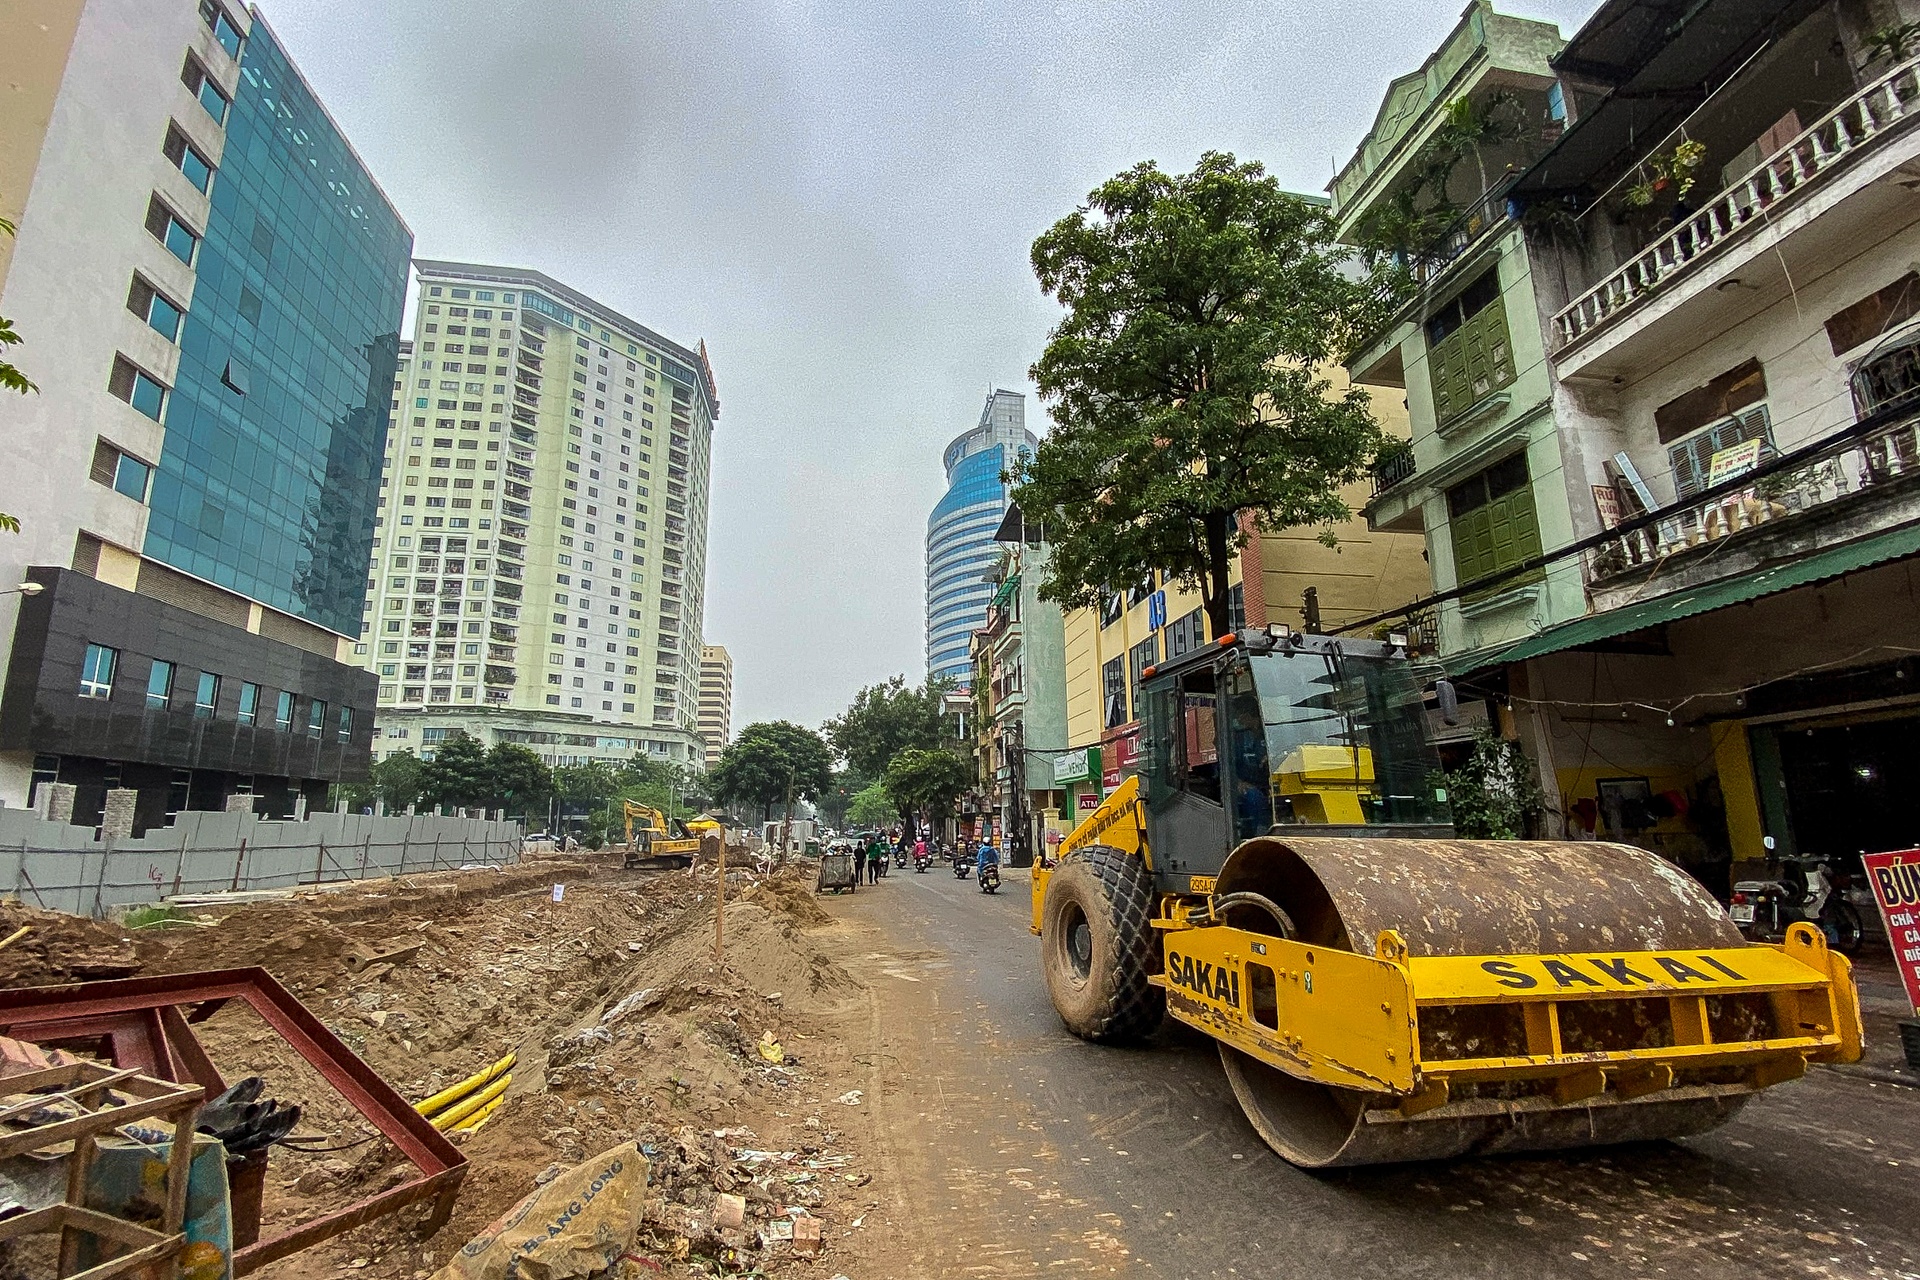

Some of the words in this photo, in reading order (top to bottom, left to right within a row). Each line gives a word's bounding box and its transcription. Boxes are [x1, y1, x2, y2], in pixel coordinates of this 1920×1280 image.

[1149, 590, 1166, 633] A3
[1169, 951, 1239, 1009] SAKAI
[1481, 956, 1748, 989] SAKAI
[582, 1159, 623, 1203] LONG
